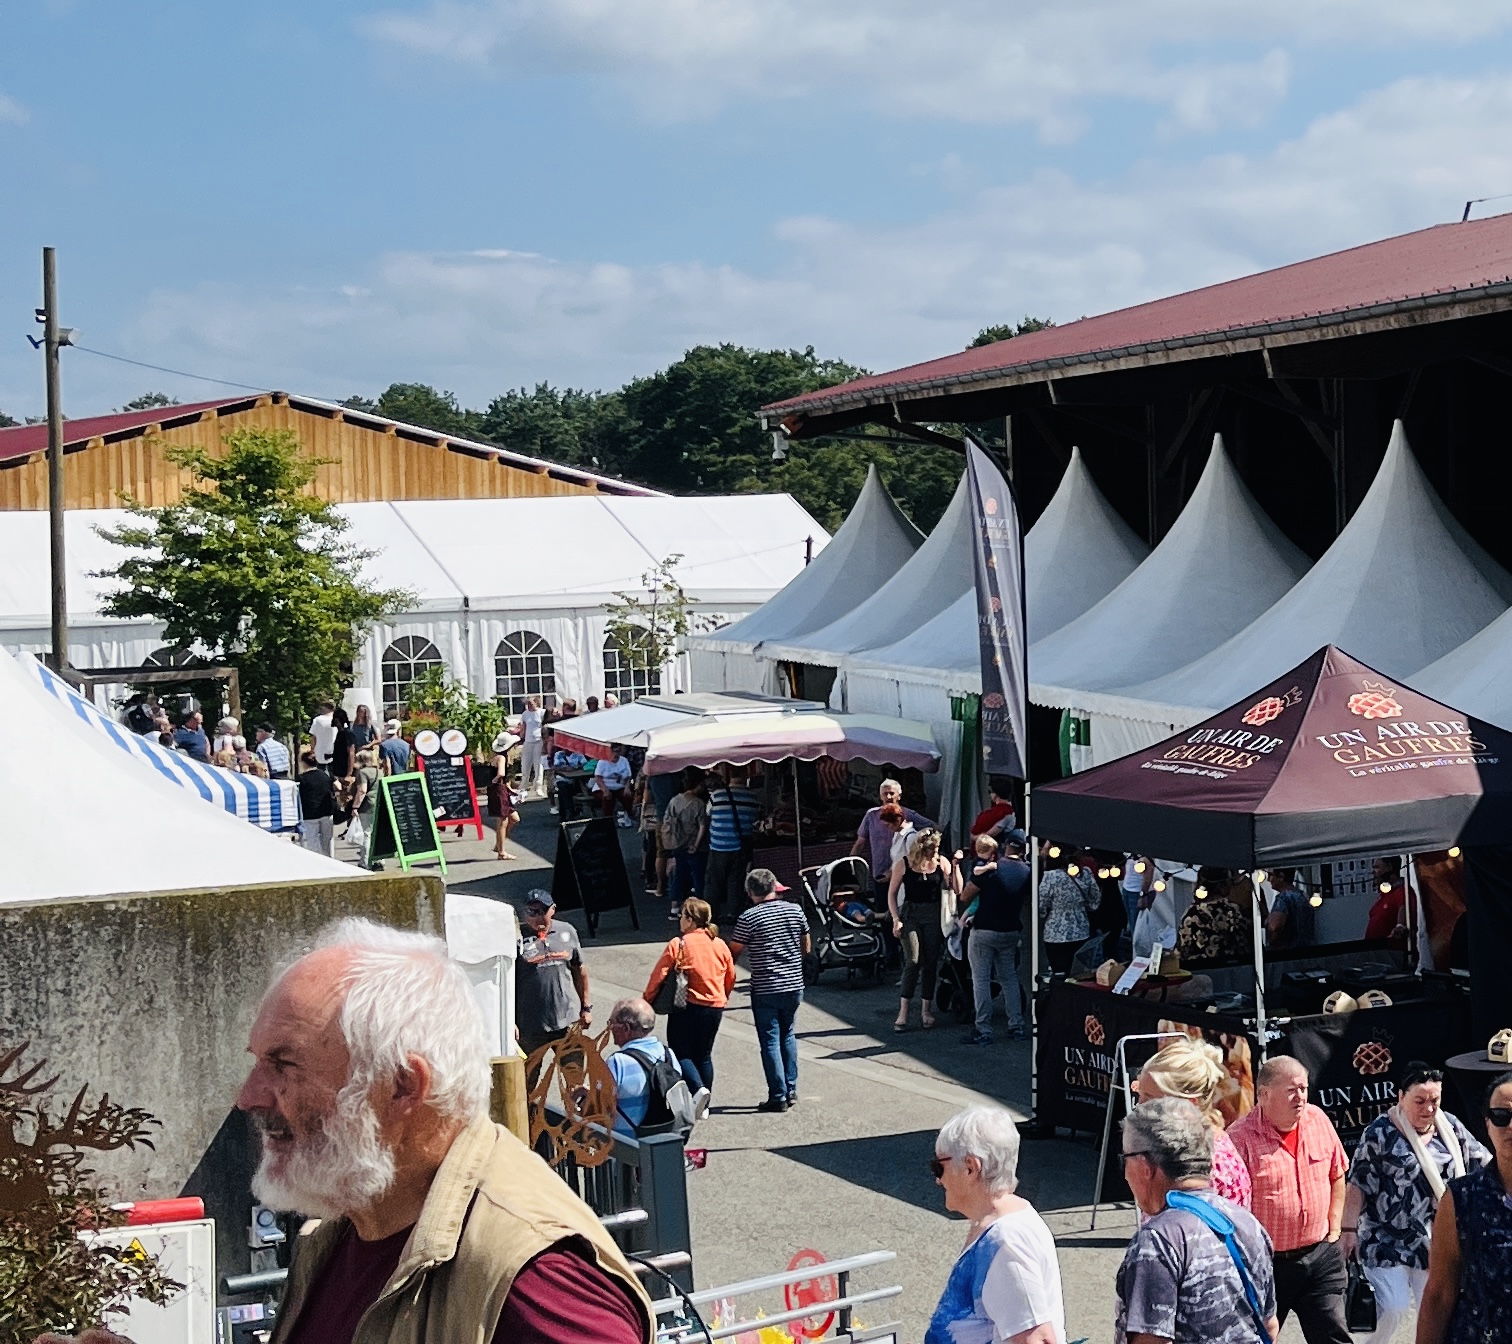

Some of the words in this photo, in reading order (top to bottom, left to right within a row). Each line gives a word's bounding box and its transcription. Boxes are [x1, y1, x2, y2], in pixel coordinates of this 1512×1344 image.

[1187, 728, 1222, 744] UN
[1216, 729, 1253, 748] AIR
[1248, 735, 1284, 754] DE
[1315, 728, 1368, 749] UN
[1376, 721, 1430, 741] AIR
[1426, 720, 1473, 736] DE
[1163, 744, 1262, 769] GAUFRES
[1333, 735, 1488, 764] GAUFRES
[1064, 1047, 1085, 1065] UN
[1088, 1052, 1108, 1071] AIR
[1318, 1086, 1352, 1107] UN
[1360, 1080, 1398, 1103] AIR
